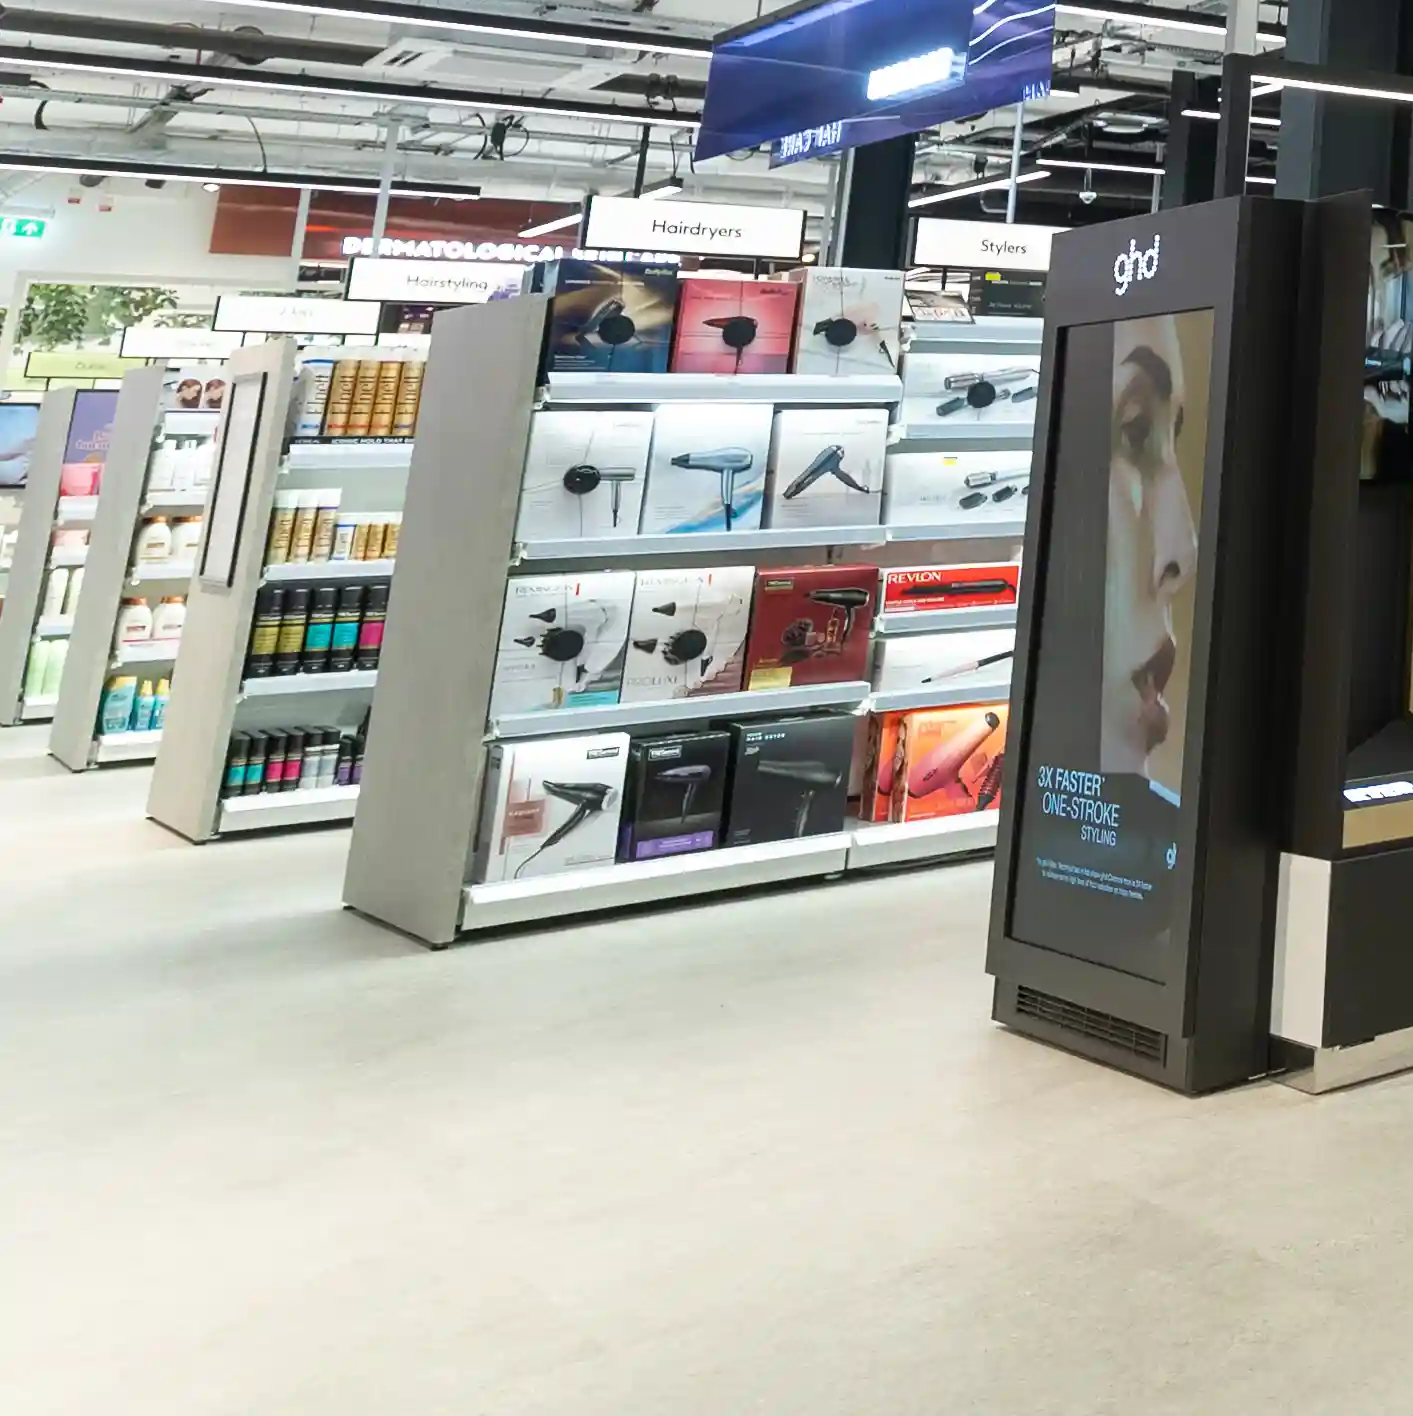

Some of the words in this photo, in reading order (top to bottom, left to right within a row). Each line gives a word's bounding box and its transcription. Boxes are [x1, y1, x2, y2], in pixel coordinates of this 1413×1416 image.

[652, 219, 743, 240] Hairdryers
[981, 239, 1027, 256] Stylers
[1114, 234, 1160, 296] ghd
[406, 275, 488, 291] Hairstyling
[888, 571, 942, 584] REVLON
[1037, 766, 1053, 788] 3X
[1042, 792, 1120, 828] ONE-STROKE
[1080, 825, 1117, 847] STYLING
